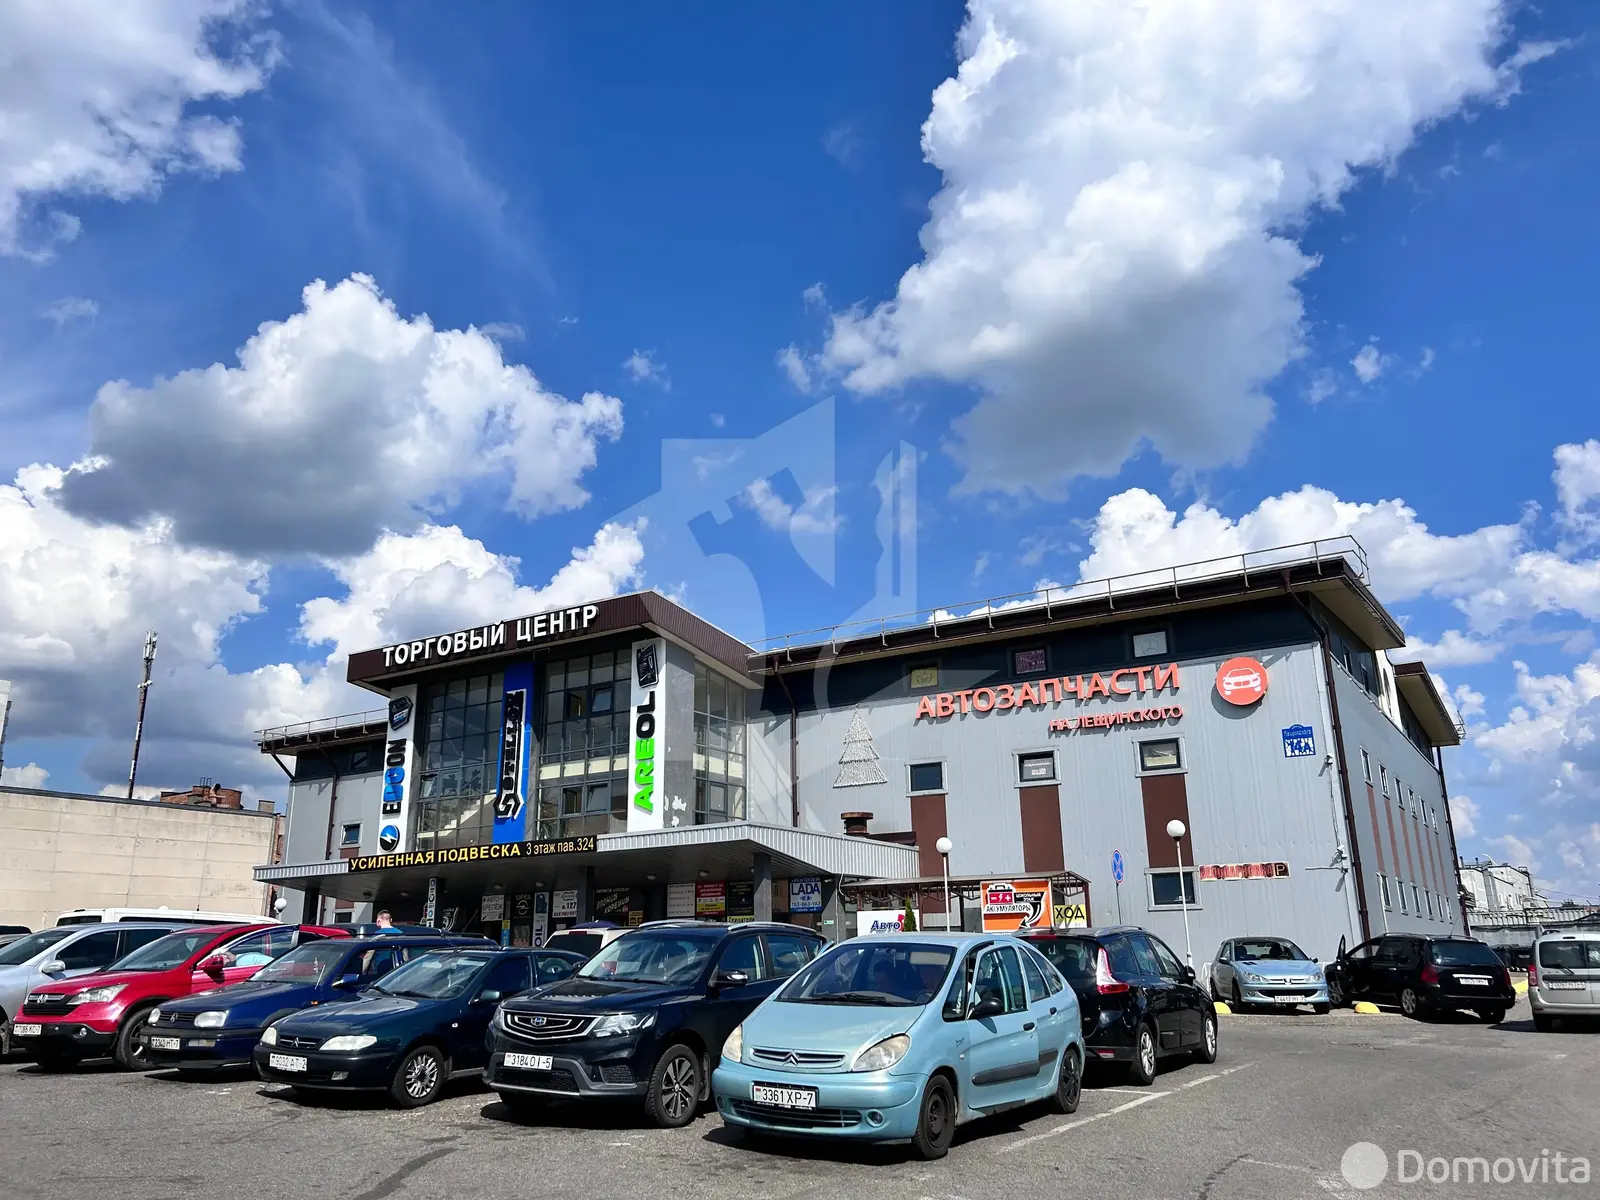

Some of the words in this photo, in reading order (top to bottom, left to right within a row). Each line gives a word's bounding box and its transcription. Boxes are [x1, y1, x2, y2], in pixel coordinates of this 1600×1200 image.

[382, 621, 505, 667] ТОРГОВЫЙ
[516, 604, 598, 642] ЦЕНТР
[915, 662, 1181, 719] АВТОЗАПЧАСТИ
[1049, 718, 1071, 732] НА
[1075, 705, 1184, 730] ЛЕЩИНСКОГО
[634, 690, 656, 813] AREOL
[382, 738, 408, 815] EDCON
[350, 850, 434, 871] УСИЛЕННАЯ
[438, 843, 521, 864] ПОДВЕСКА
[526, 842, 532, 855] 3
[533, 841, 556, 855] этаж
[557, 837, 594, 853] пав.324
[791, 882, 820, 895] LADA
[986, 904, 1031, 912] АККУМУЛЯТОРЫ
[1055, 907, 1085, 920] ХОД
[511, 1054, 529, 1067] 3184
[762, 1088, 784, 1102] 3361
[786, 1090, 813, 1105] XP-7
